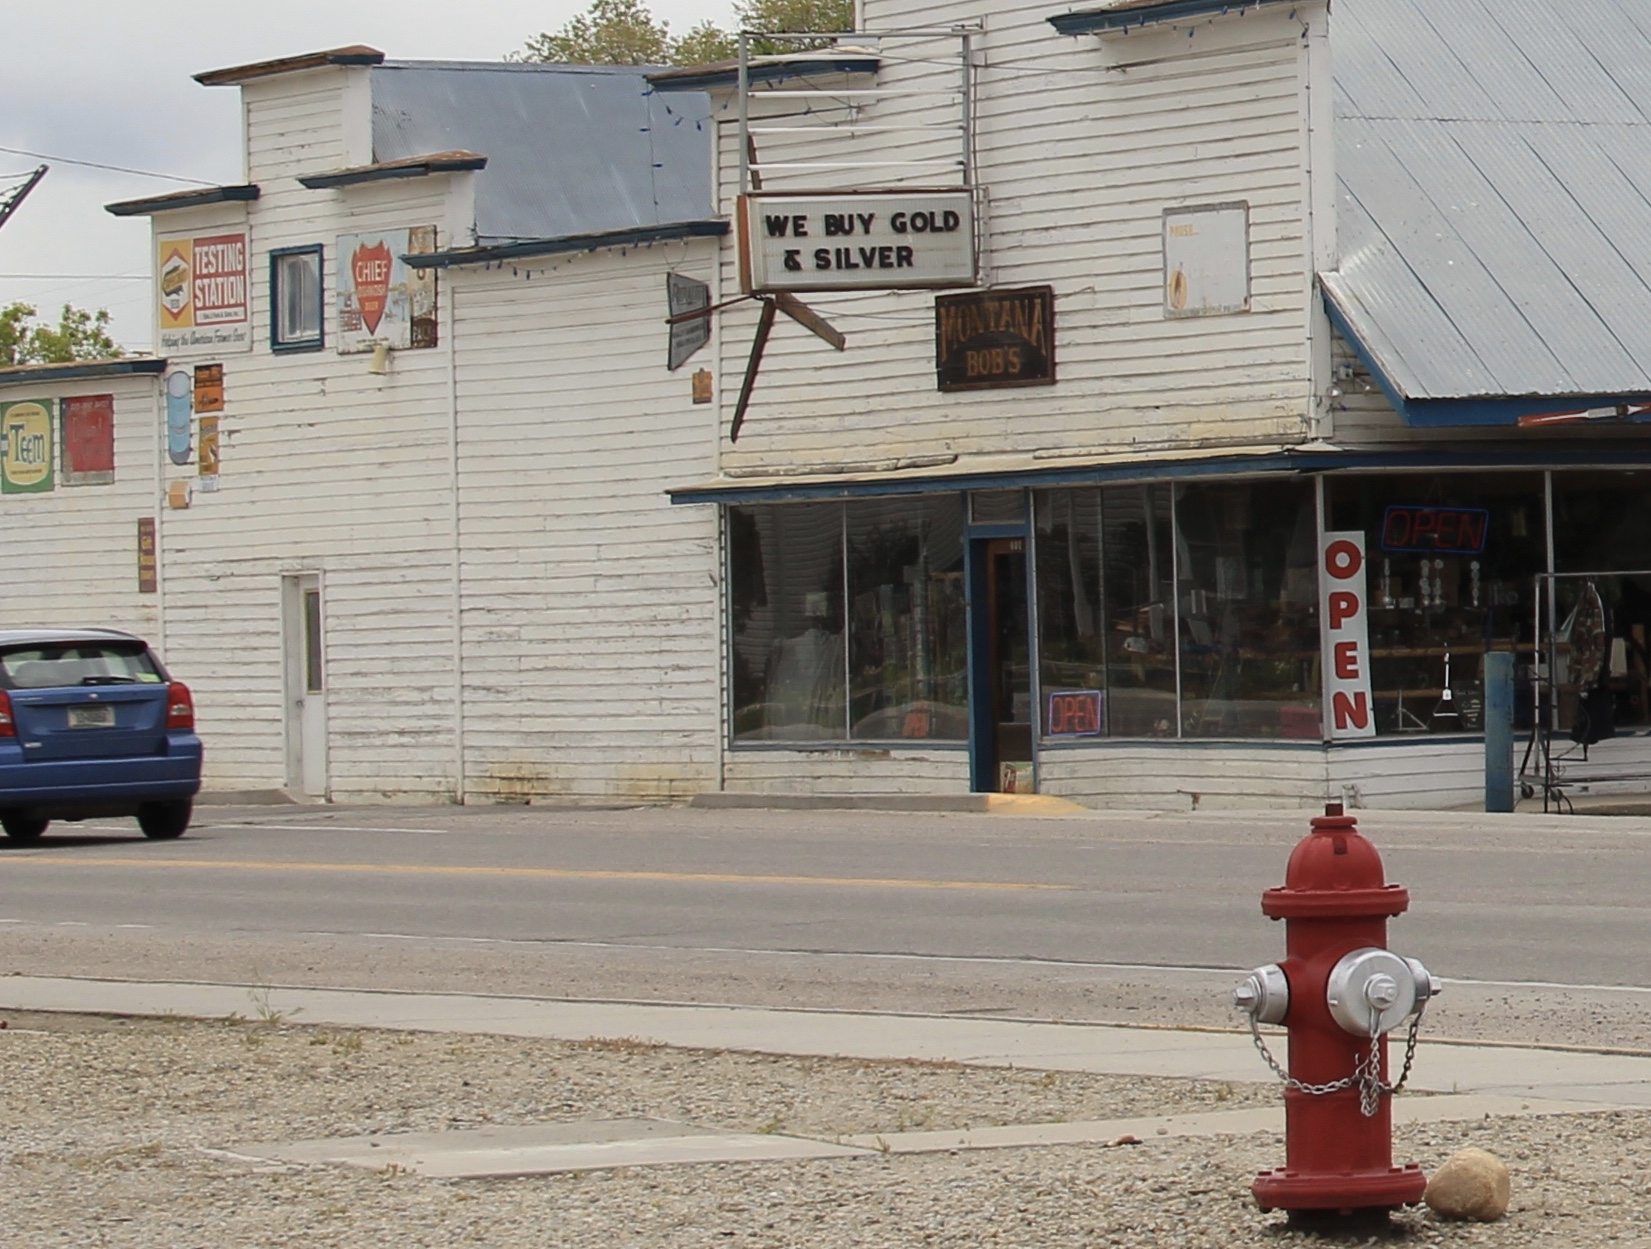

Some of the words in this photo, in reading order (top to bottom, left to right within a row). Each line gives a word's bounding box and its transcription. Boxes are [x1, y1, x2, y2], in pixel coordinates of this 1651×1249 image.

[766, 215, 807, 237] WE
[825, 213, 875, 235] BUY
[891, 210, 960, 232] GOLD
[195, 242, 243, 275] TESTING
[356, 260, 387, 282] CHIEF
[784, 250, 802, 271] &
[814, 246, 914, 270] SILVER
[195, 275, 244, 308] STATION
[940, 298, 1046, 363] MONTANA
[966, 350, 1021, 377] BOB'S
[1385, 510, 1483, 549] OPEN
[1325, 540, 1368, 730] OPEN
[1051, 696, 1098, 733] OPEN
